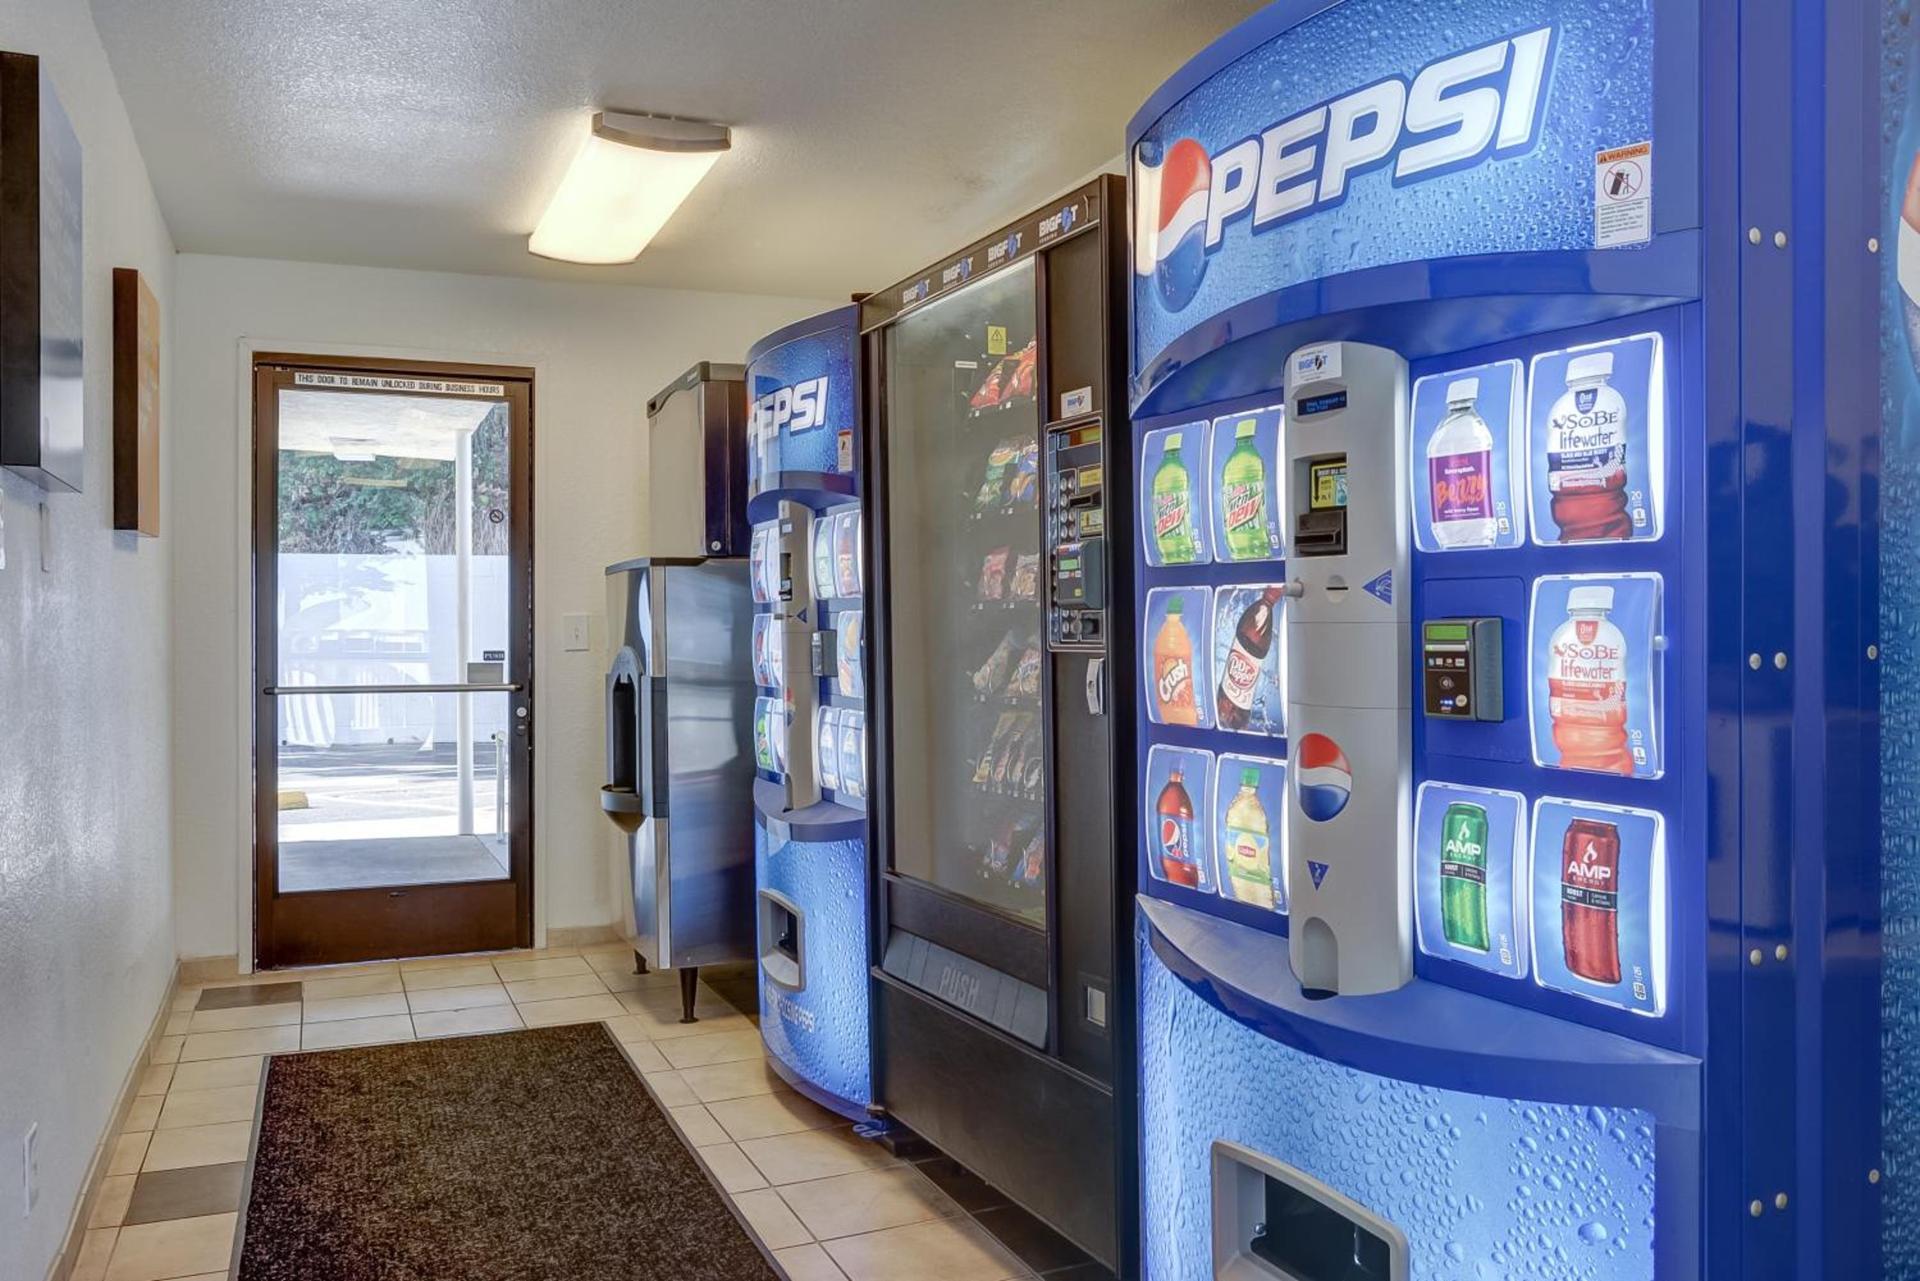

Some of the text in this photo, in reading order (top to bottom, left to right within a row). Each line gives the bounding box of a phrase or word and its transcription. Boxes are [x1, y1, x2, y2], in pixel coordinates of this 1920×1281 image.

[1204, 26, 1552, 248] PEPSI
[1607, 145, 1649, 160] WARNING
[298, 374, 500, 394] THIS DOOR TO REMAIN UNLOCKED DURING BUSINESS HOURS
[1560, 427, 1614, 450] lifewater
[1159, 658, 1188, 702] Crush
[1560, 659, 1615, 680] lifewater
[1446, 839, 1482, 856] AMP
[1567, 860, 1611, 880] AMP
[938, 965, 981, 1009] PUSH
